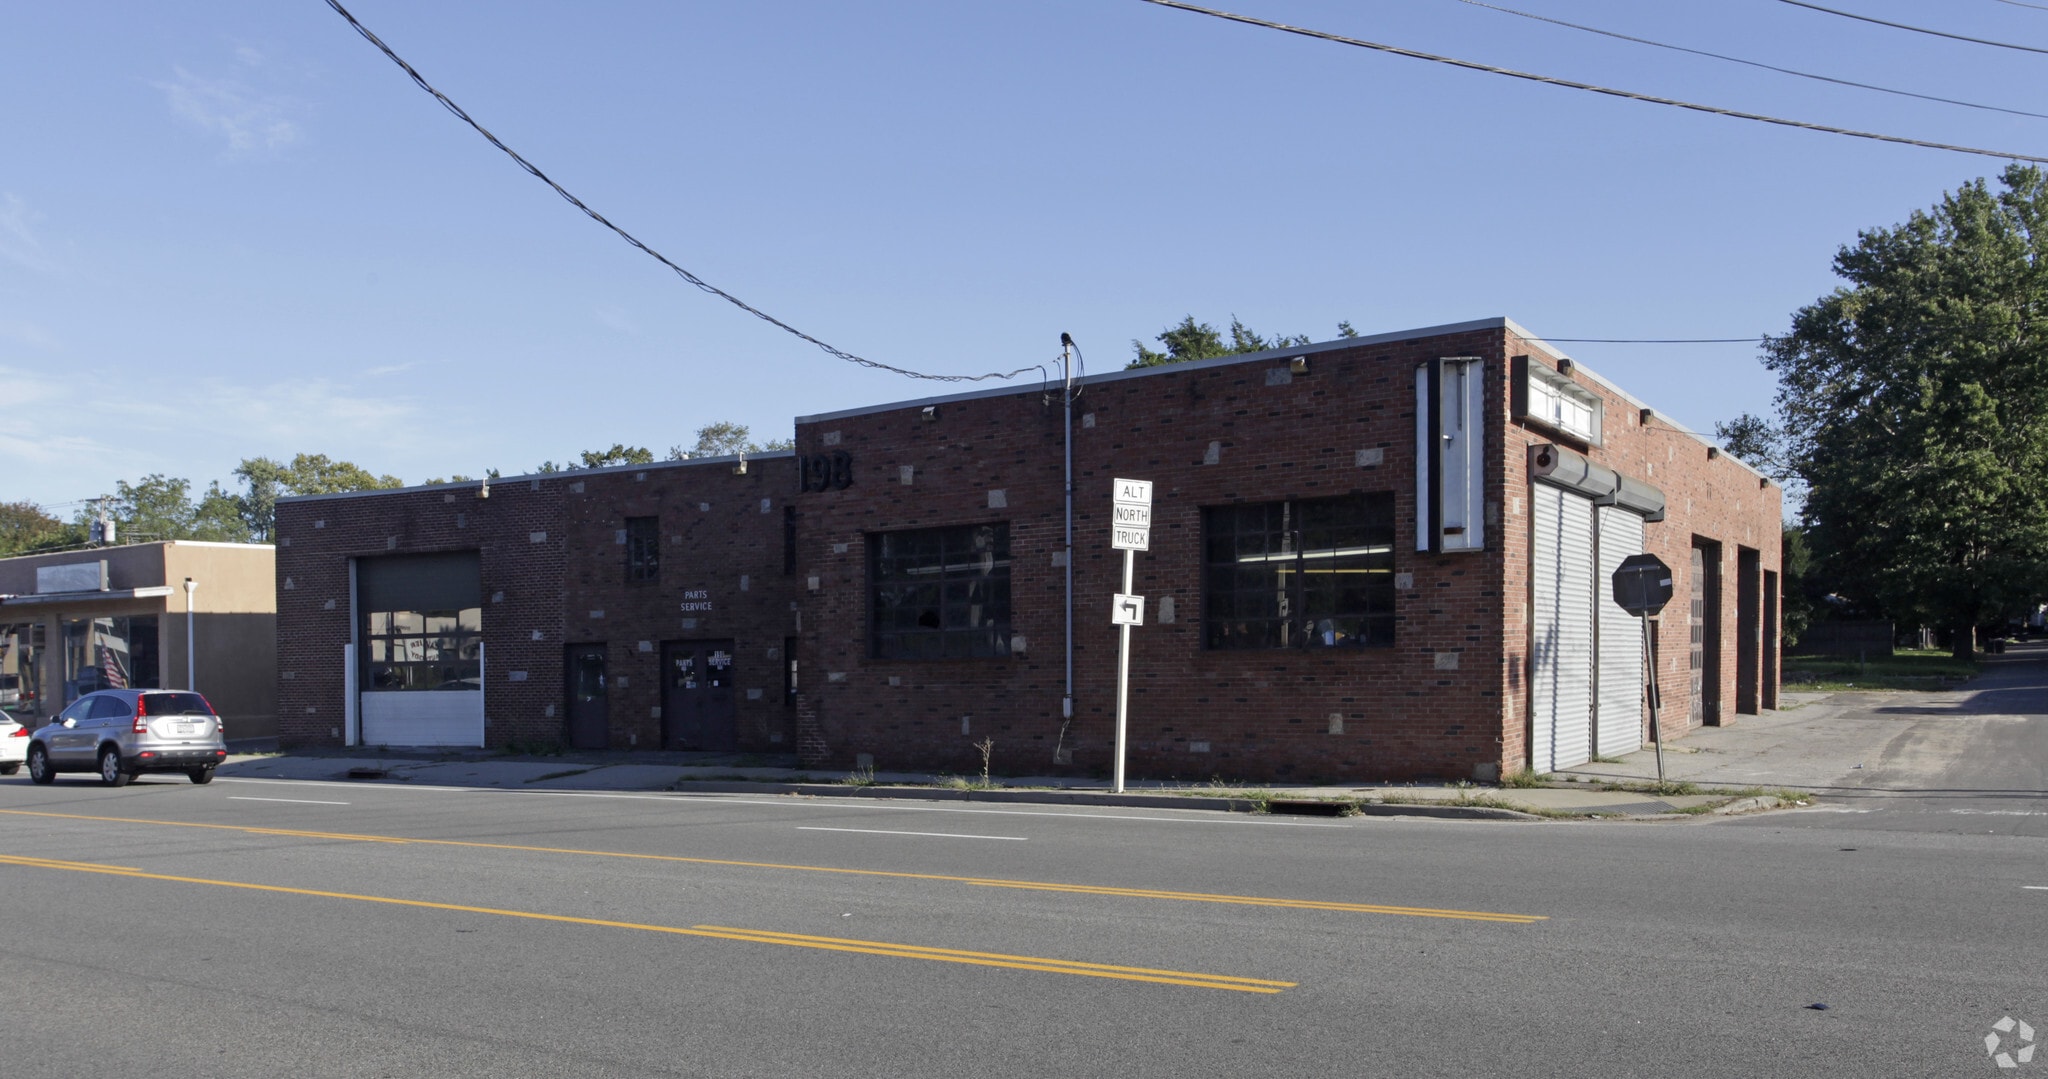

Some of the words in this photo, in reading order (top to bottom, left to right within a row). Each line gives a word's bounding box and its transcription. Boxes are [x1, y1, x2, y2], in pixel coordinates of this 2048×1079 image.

[1123, 485, 1144, 498] ALT
[1116, 507, 1148, 522] NORTH
[1116, 530, 1146, 545] TRUCK
[685, 590, 708, 599] PARTS
[681, 602, 712, 611] SERVICE
